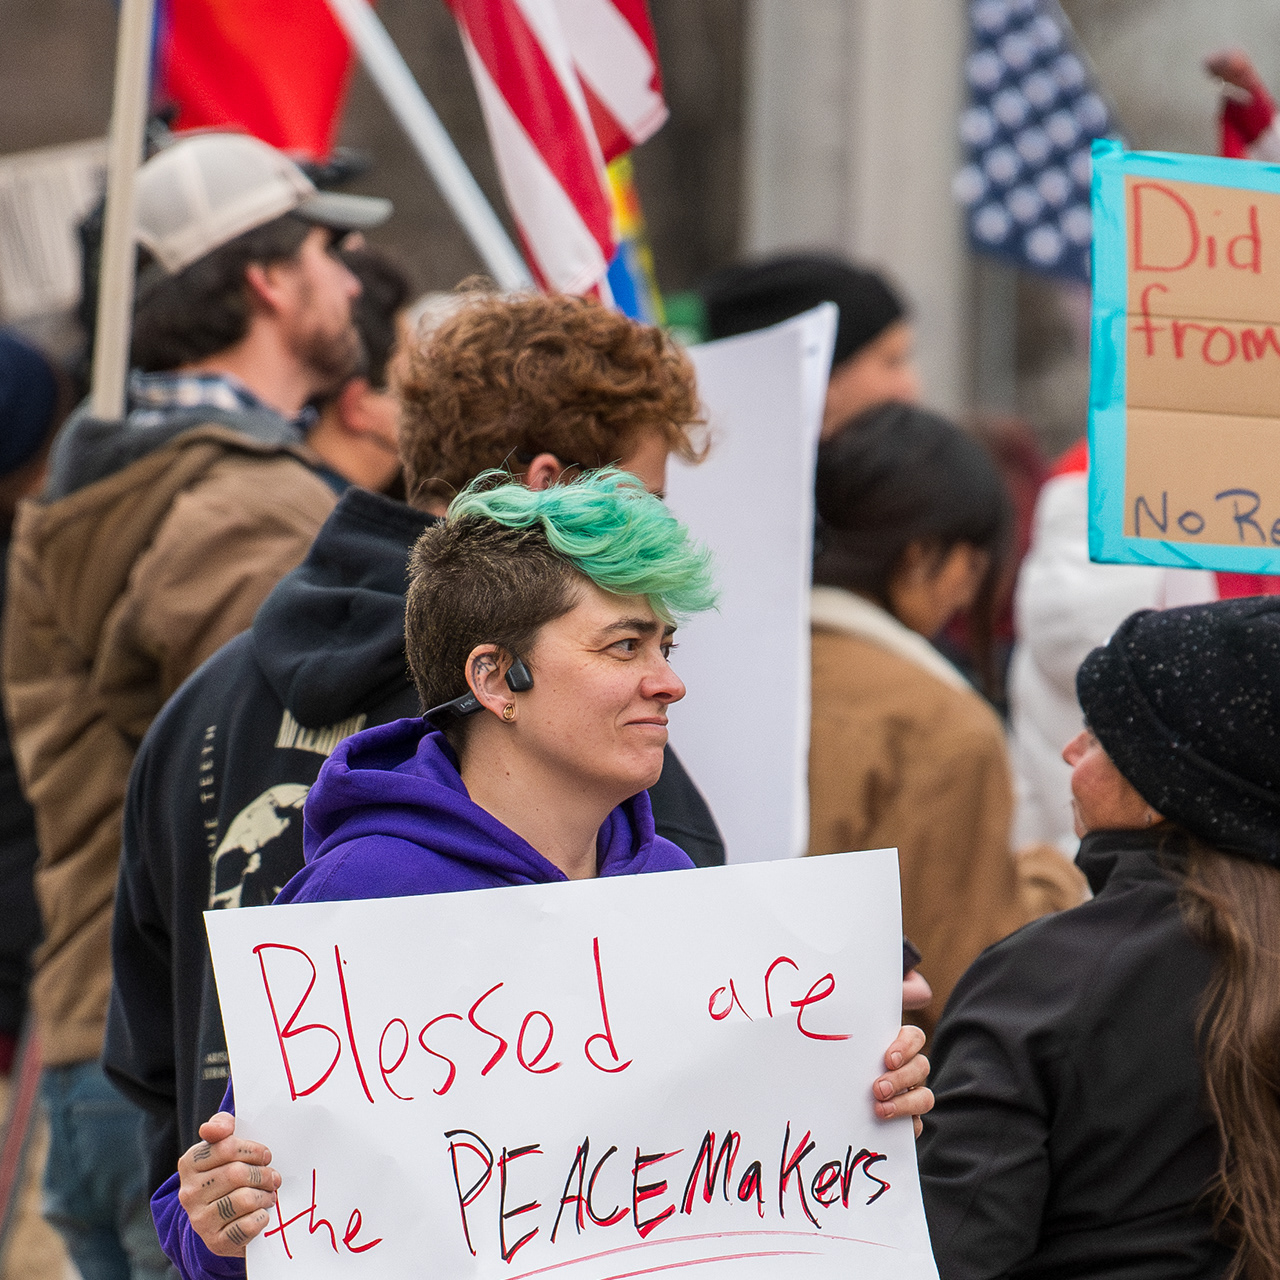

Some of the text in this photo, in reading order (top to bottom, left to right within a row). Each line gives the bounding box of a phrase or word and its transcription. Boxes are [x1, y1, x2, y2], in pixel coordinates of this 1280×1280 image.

[1132, 183, 1262, 274] Did
[1134, 492, 1205, 536] No
[252, 936, 854, 1105] Blessed are
[264, 1169, 383, 1260] the
